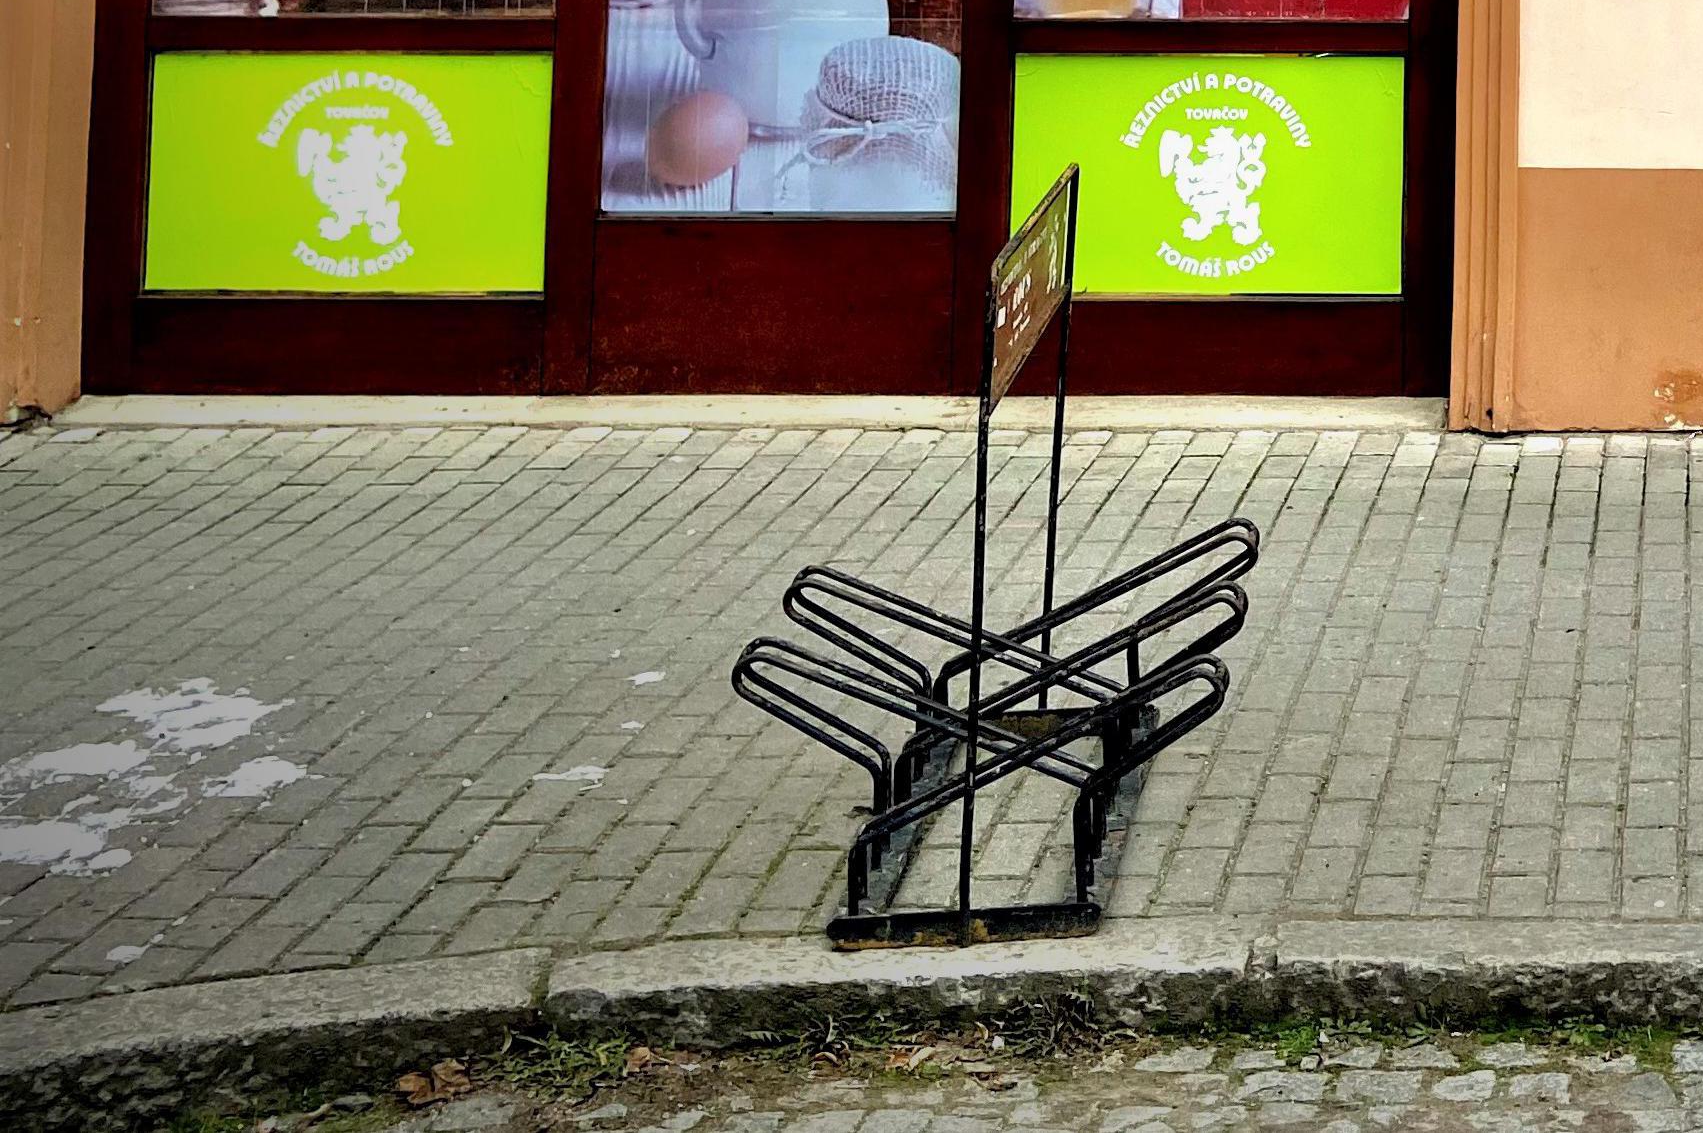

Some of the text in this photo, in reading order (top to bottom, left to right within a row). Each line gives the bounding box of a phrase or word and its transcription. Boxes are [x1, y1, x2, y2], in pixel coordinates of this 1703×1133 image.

[345, 72, 359, 88] A
[1205, 74, 1219, 90] A
[1223, 74, 1312, 147] POTRAVINY
[1226, 241, 1275, 276] ROUS
